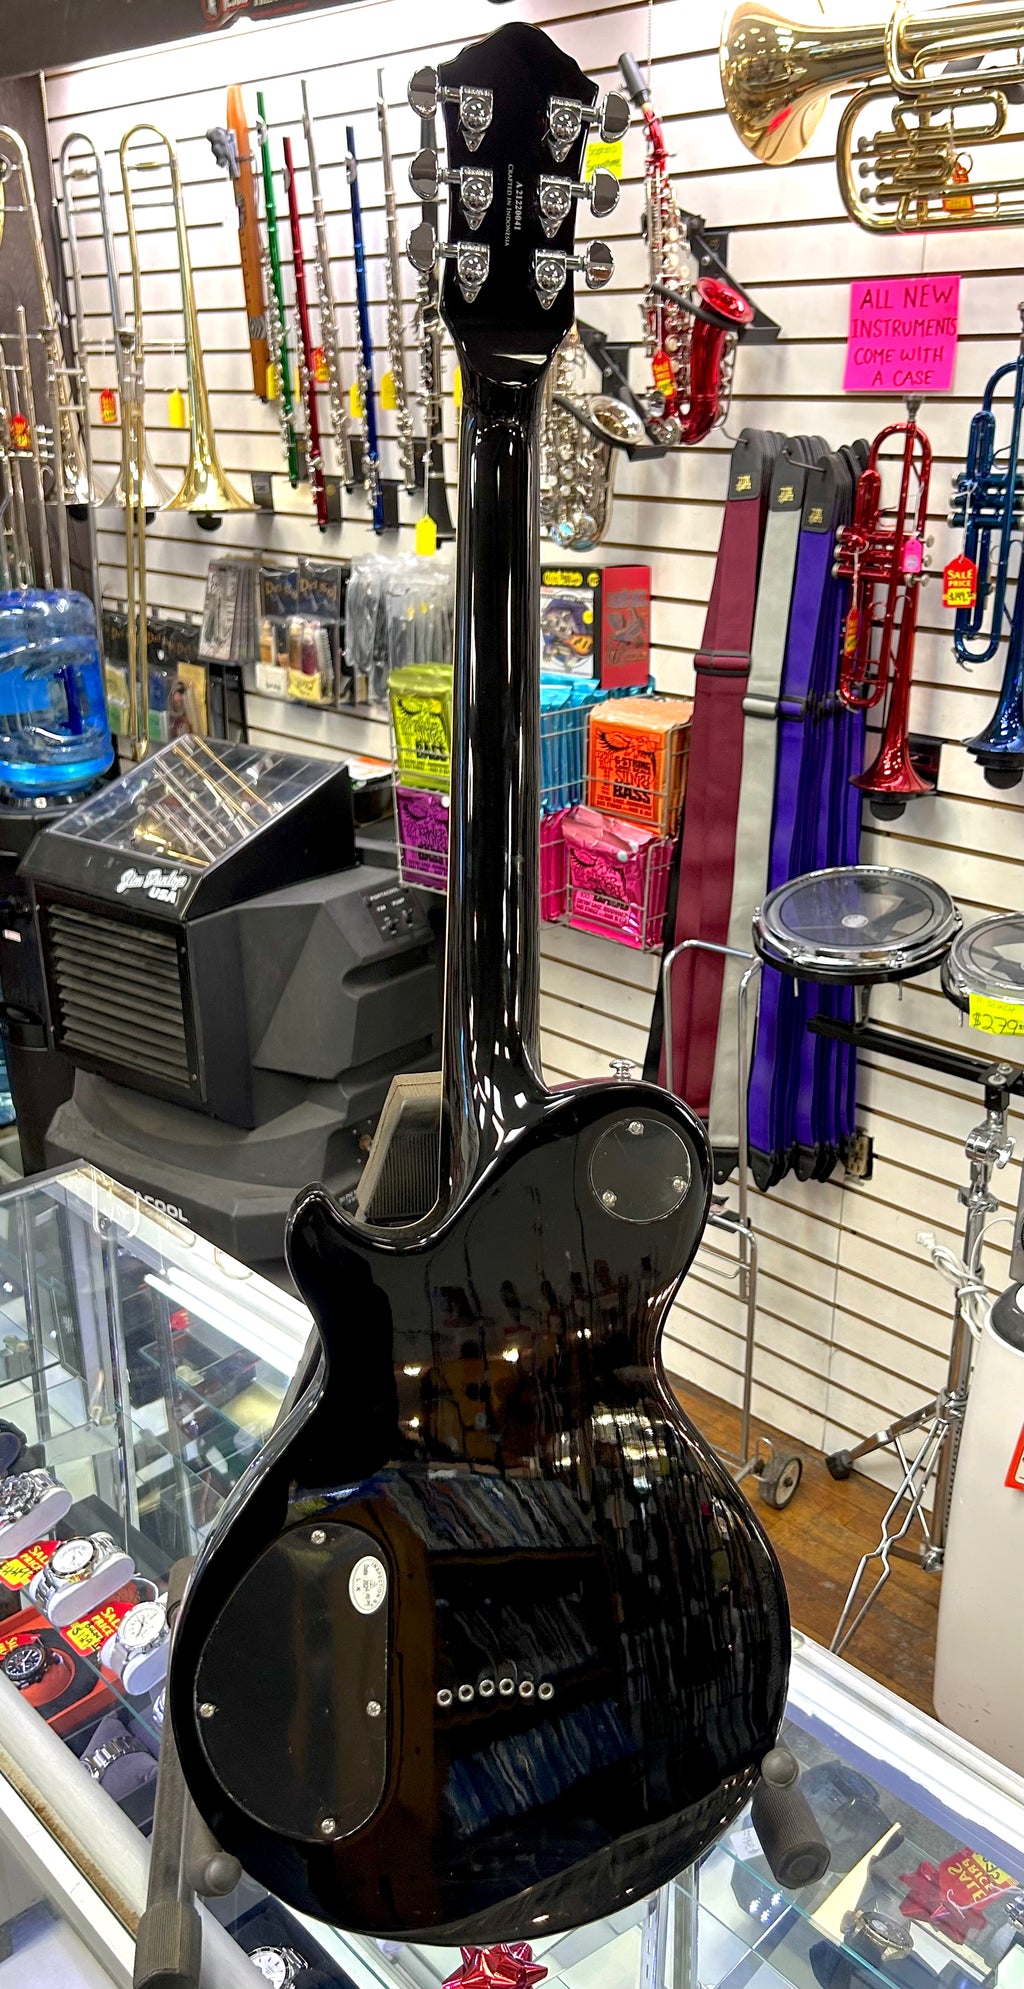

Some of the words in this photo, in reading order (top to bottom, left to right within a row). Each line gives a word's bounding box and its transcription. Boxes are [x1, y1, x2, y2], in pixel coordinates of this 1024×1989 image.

[504, 207, 512, 247] INDONESIA
[859, 288, 894, 310] ALL
[903, 283, 953, 309] NEW
[851, 317, 958, 338] INSTRUMENTS
[853, 347, 896, 366] COME
[900, 345, 945, 364] WITH
[871, 370, 883, 387] A
[892, 369, 935, 387] CASE
[947, 569, 974, 580] SALE
[948, 579, 972, 588] PRICE
[613, 784, 651, 804] BASS
[148, 886, 177, 904] USA
[28, 1545, 49, 1566] SAL
[91, 1614, 115, 1637] PRICE
[100, 1606, 120, 1629] SAL
